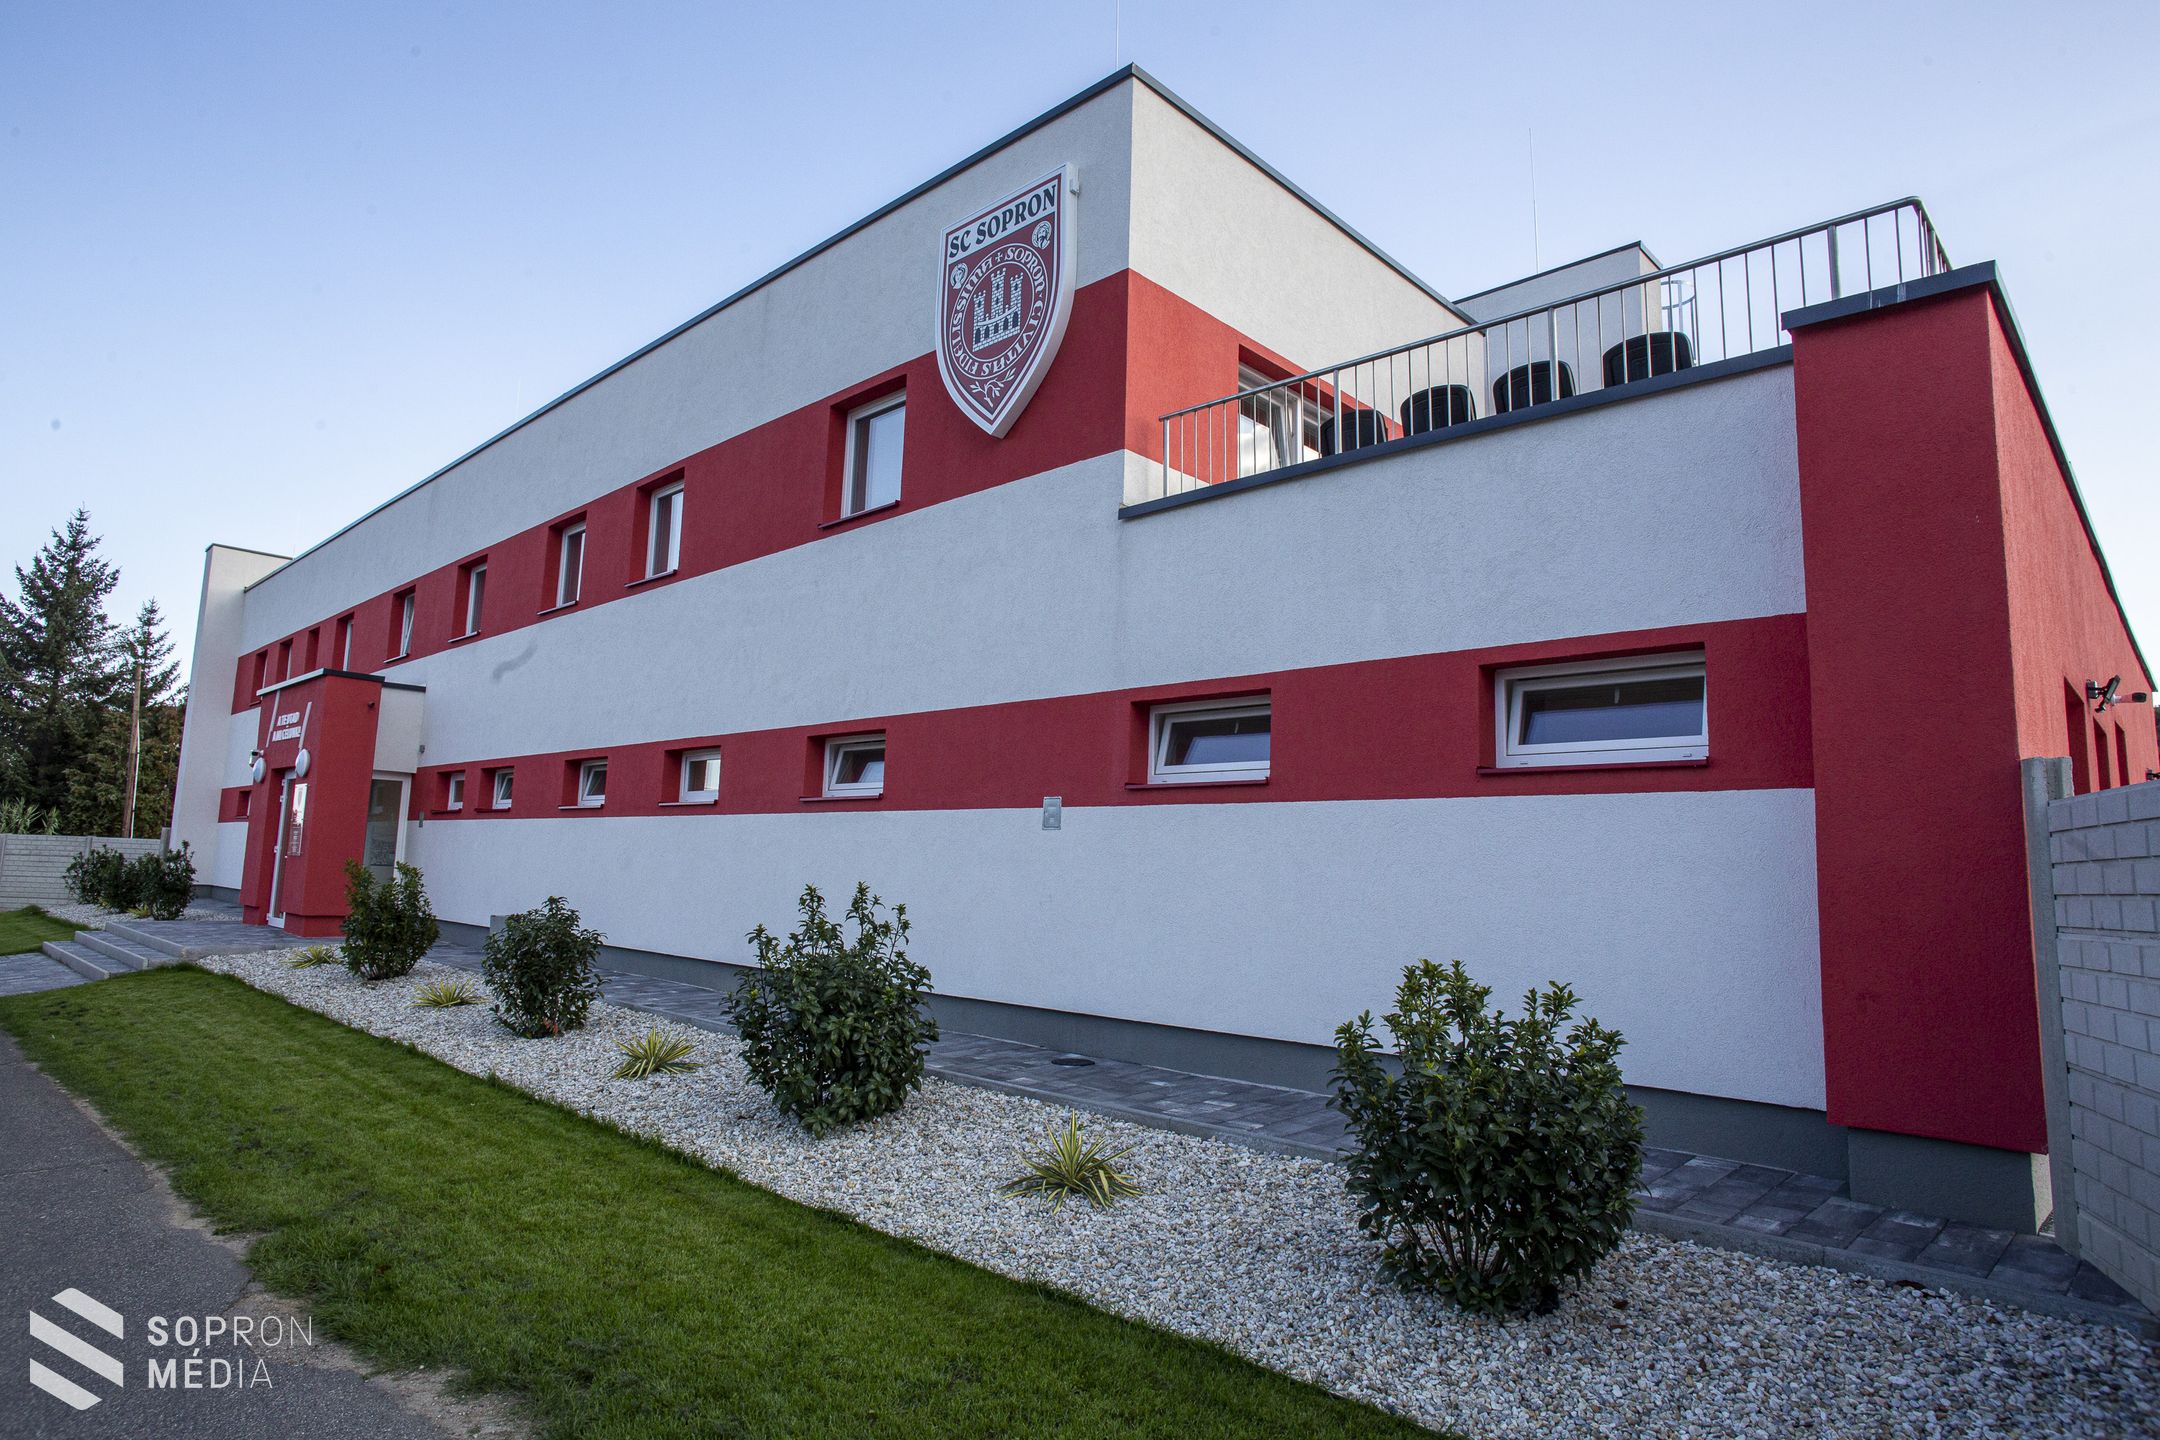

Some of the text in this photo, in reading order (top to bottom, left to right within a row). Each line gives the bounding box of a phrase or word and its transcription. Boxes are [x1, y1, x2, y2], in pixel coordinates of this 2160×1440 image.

[949, 184, 1057, 258] SC SOPRON
[981, 300, 1044, 376] CIVITAS
